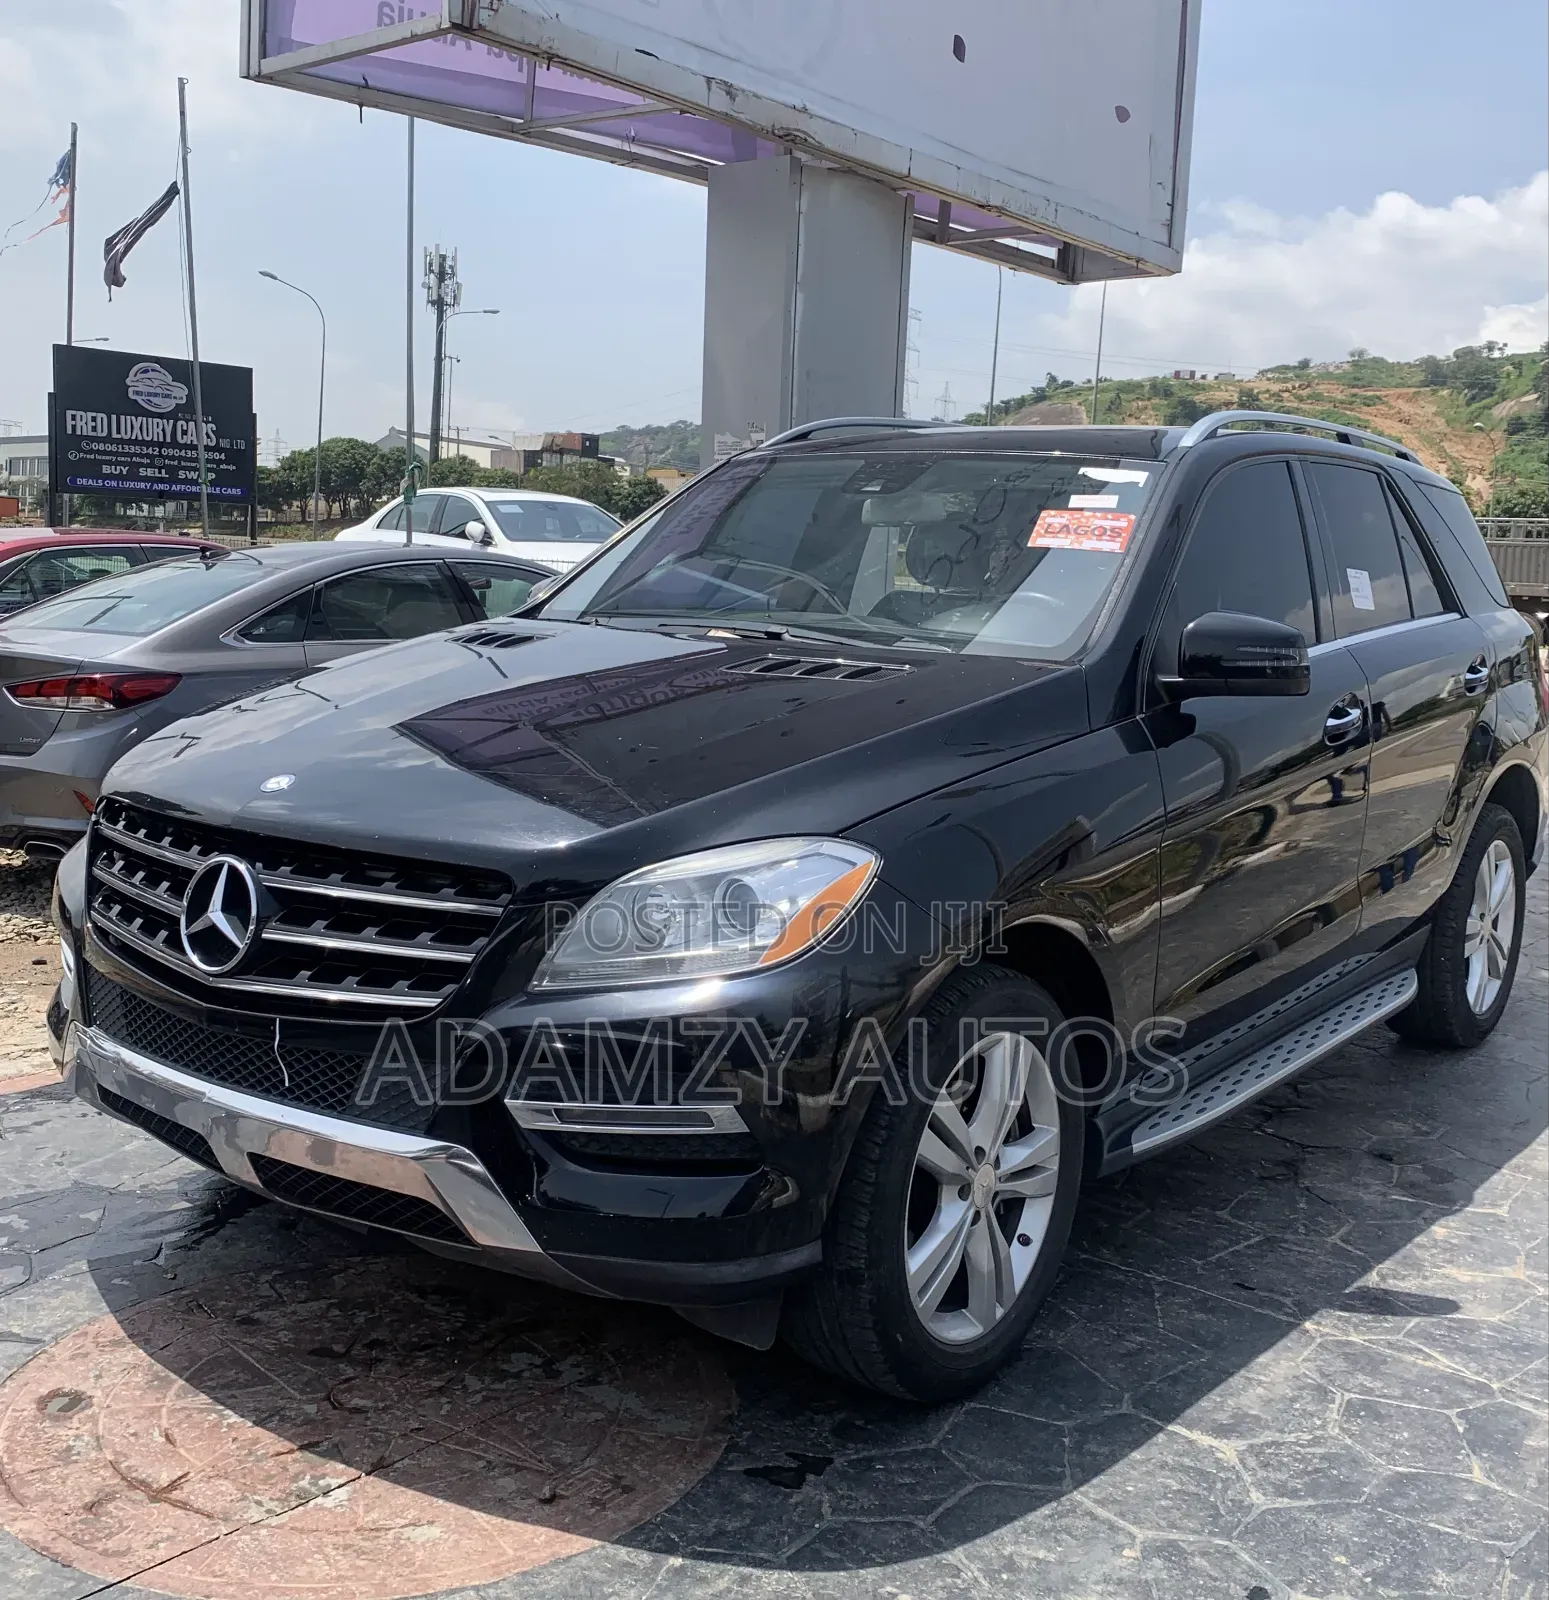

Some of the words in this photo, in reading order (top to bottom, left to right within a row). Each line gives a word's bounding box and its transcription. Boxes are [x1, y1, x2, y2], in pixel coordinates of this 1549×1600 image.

[65, 409, 108, 437] FRED
[110, 414, 174, 443] LUXURY
[91, 442, 160, 455] 08061335342
[233, 440, 246, 450] LTD
[95, 454, 117, 462] luxury
[132, 457, 151, 465] Abuja
[102, 465, 130, 475] BUY
[139, 468, 169, 478] SELL
[178, 470, 216, 483] SWP
[76, 478, 103, 486] DEALS
[119, 481, 152, 490] LUXURY
[221, 487, 242, 495] CARS
[1044, 523, 1123, 539] LAGOS
